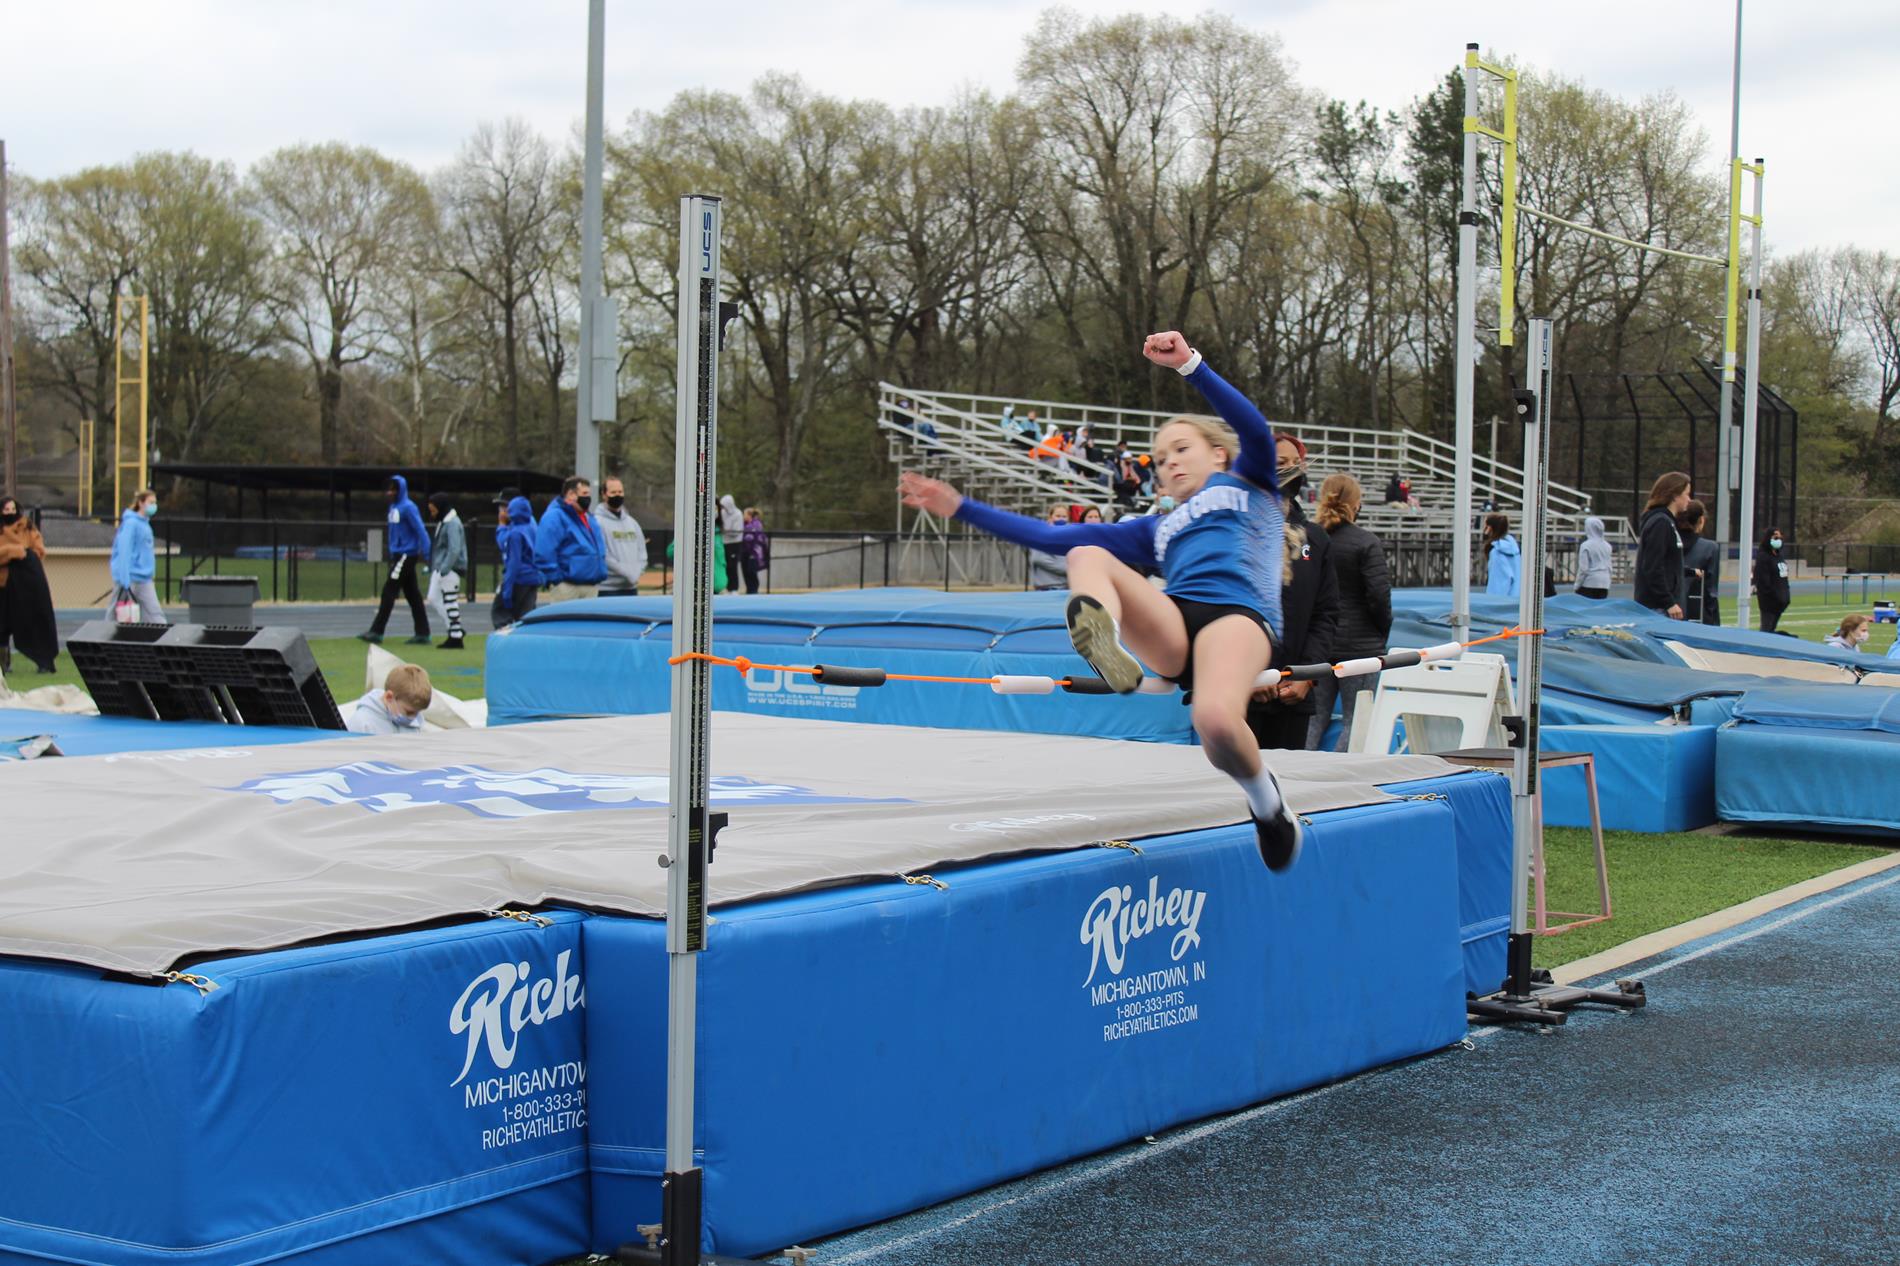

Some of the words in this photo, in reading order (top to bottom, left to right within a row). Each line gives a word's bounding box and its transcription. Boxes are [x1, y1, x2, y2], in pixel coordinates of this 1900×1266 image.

[702, 211, 712, 272] UCS
[745, 664, 860, 696] UC
[1080, 875, 1207, 988] Richey
[1091, 965, 1189, 1006] MICHIGANTOWN,
[1193, 960, 1206, 982] IN
[450, 949, 586, 1087] Rich
[1103, 1004, 1198, 1041] RICHEYATHLETICS.COM
[1116, 991, 1185, 1019] 1-800-333-PITS
[482, 1109, 588, 1150] RICHEYATHLETIC
